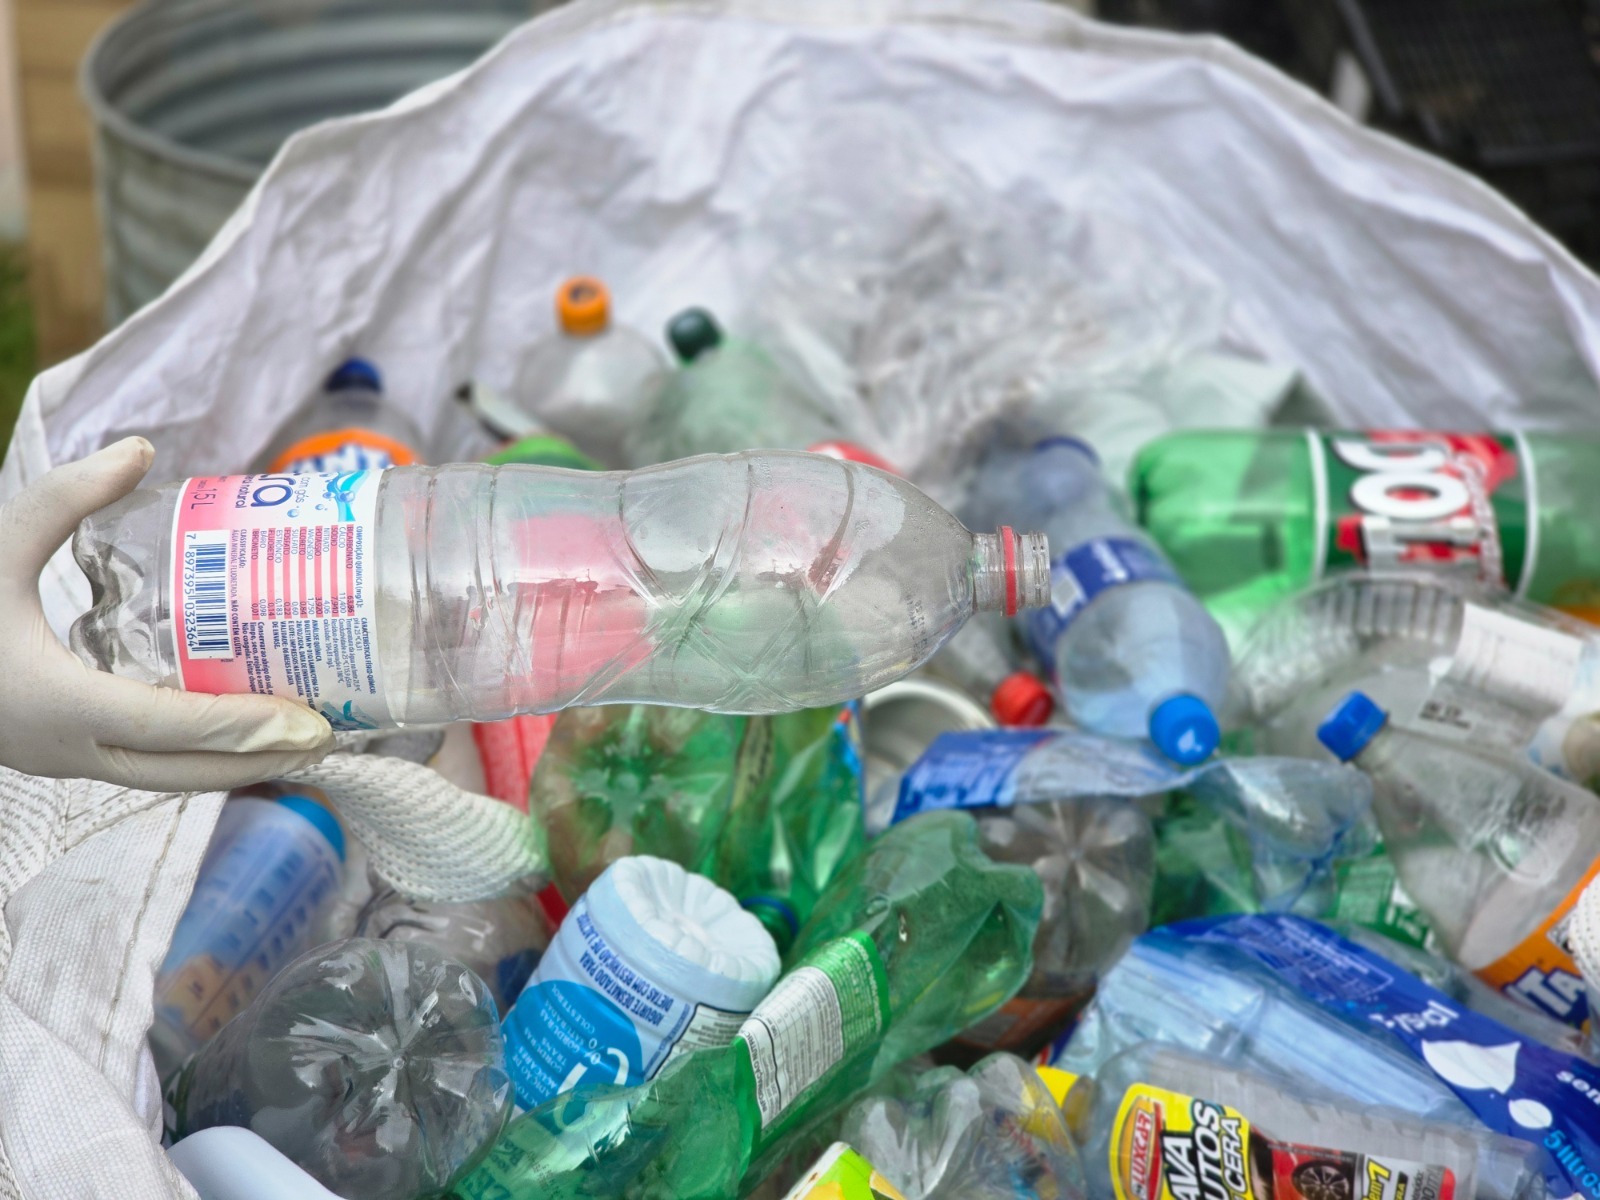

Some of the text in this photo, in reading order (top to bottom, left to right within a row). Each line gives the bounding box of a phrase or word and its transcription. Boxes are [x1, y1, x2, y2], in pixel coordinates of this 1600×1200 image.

[191, 489, 217, 500] 1,5
[235, 485, 250, 508] natural
[295, 490, 308, 503] gás
[238, 529, 247, 568] CLASSIFICAÇÃO:
[184, 552, 195, 594] 897395
[184, 602, 198, 647] 032364
[232, 613, 240, 635] CONTÉM
[346, 618, 354, 646] Temperatura
[290, 639, 299, 664] IMPRESSOS
[361, 618, 371, 659] CARACTERÍSTICAS
[243, 636, 251, 659] congelar.
[249, 676, 258, 694] choque
[261, 658, 269, 674] abrigo
[590, 939, 606, 956] DE
[580, 950, 597, 976] PARA
[598, 948, 637, 985] RESTRIÇÃO
[594, 966, 636, 1009] DESNATADO
[635, 976, 650, 997] COM
[646, 988, 674, 1013] DIETAS
[552, 984, 595, 1034] COLESTEROL
[631, 1000, 664, 1027] IOGURTE
[540, 1009, 580, 1053] GORDURAS
[754, 1061, 768, 1113] INFORMAÇÃO
[1132, 1112, 1151, 1186] LUXCAR
[1544, 1130, 1566, 1149] 5
[1220, 1118, 1246, 1193] CERA
